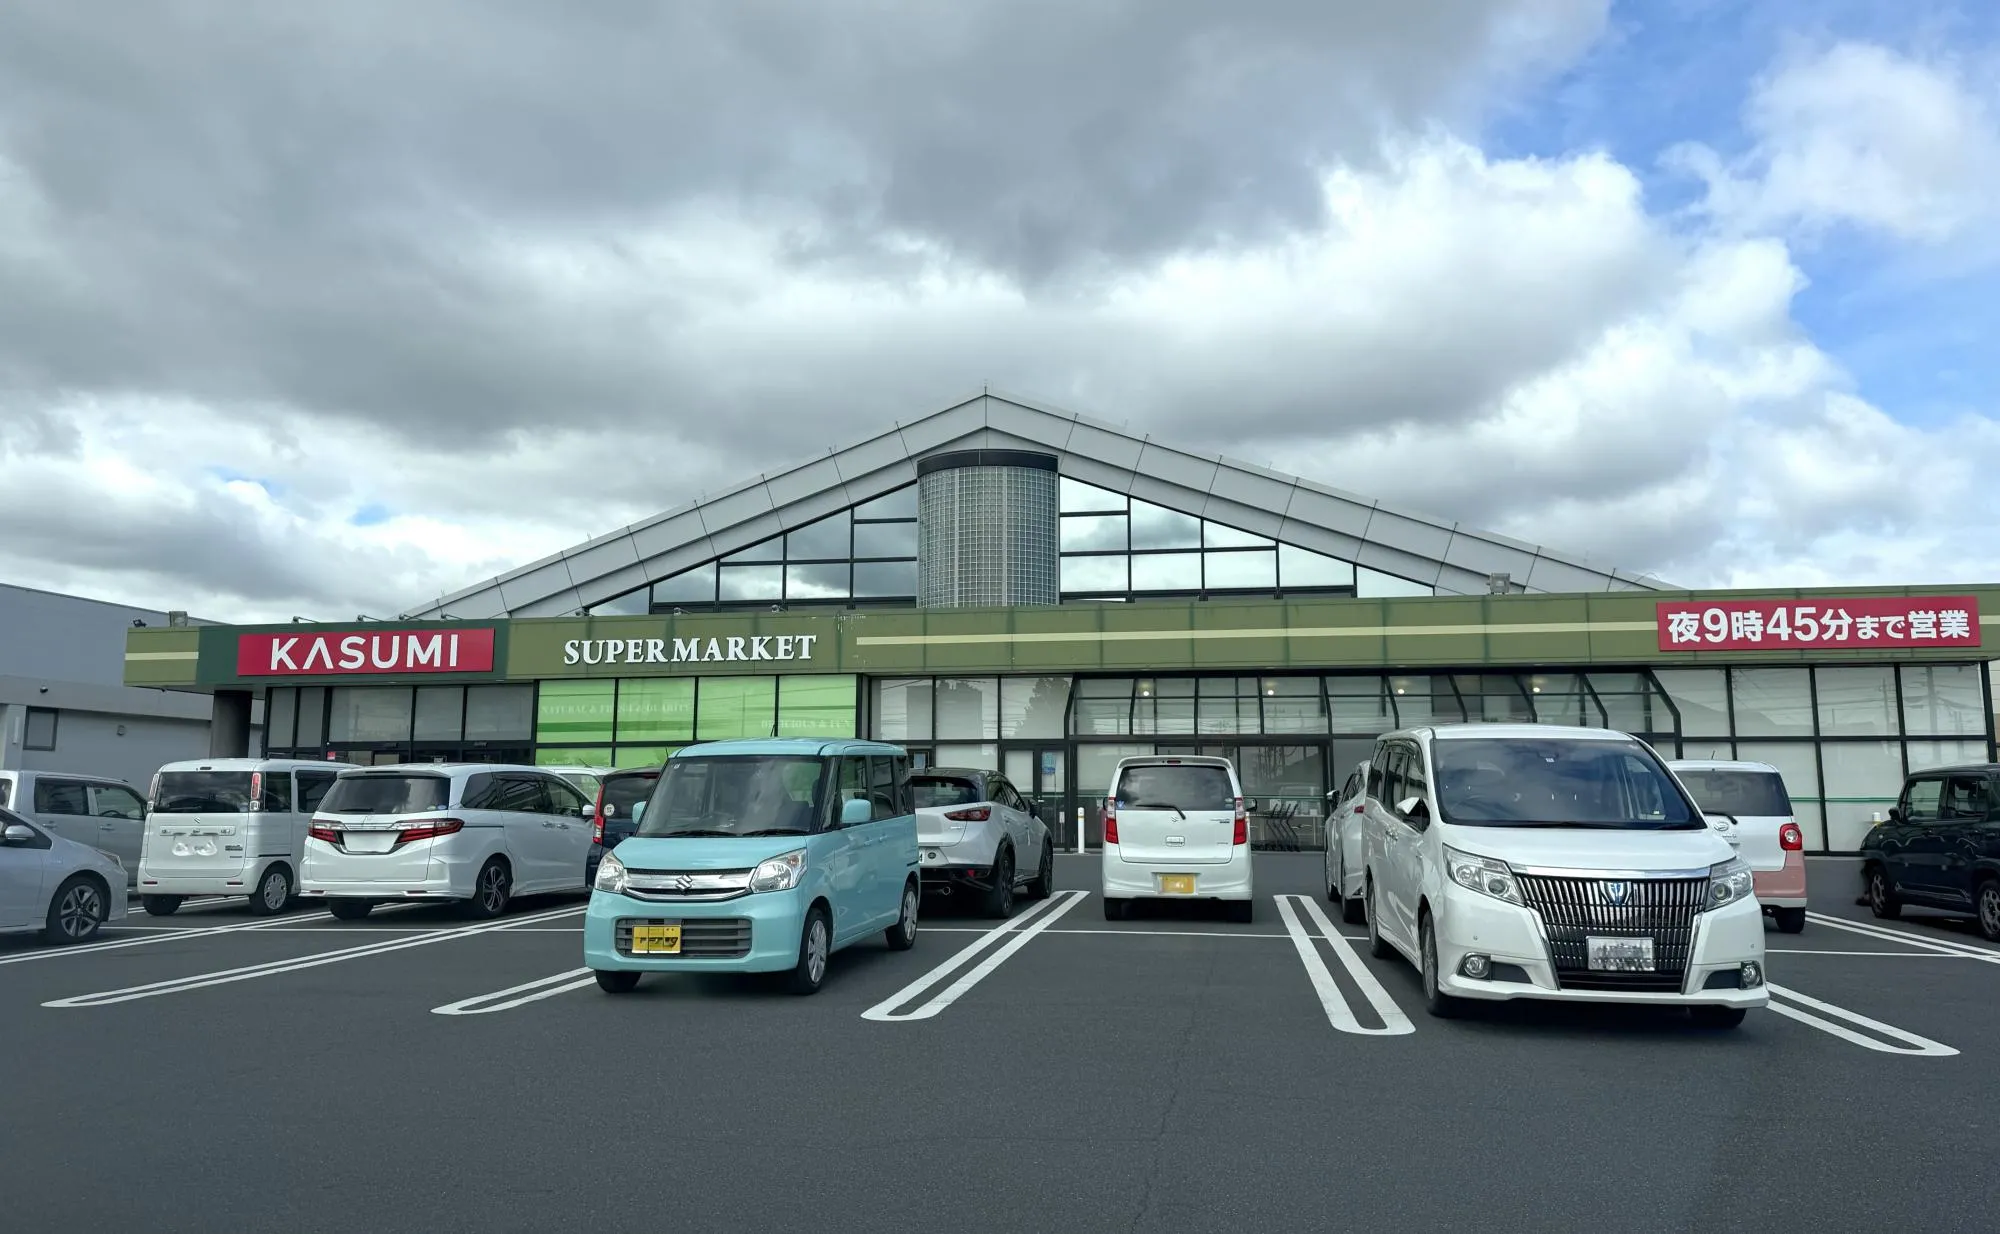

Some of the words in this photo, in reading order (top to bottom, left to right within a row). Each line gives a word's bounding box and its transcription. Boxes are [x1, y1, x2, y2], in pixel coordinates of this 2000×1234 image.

[1667, 606, 1970, 643] 夜9時45分まで営業
[270, 634, 459, 671] KASUMI
